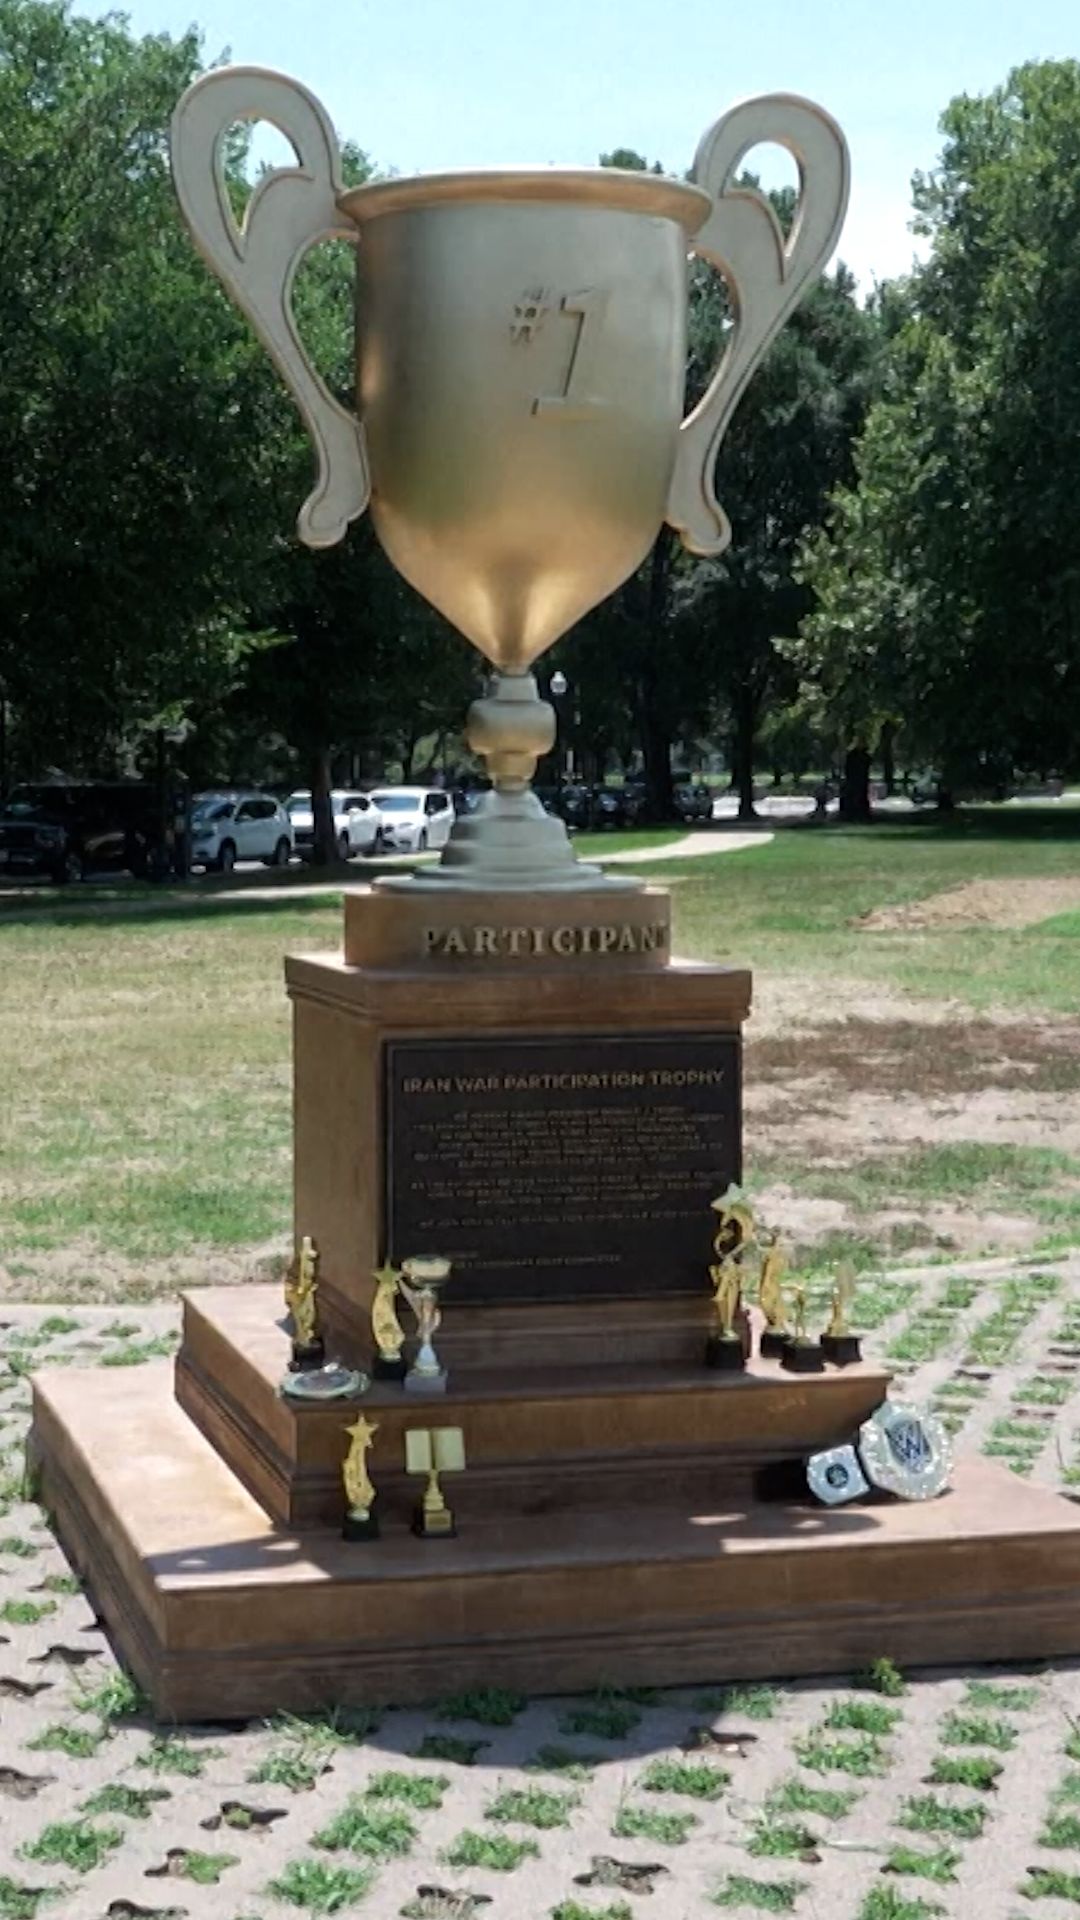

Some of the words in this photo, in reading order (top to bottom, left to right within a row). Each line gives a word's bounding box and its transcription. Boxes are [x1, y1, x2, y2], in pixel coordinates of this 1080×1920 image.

[507, 284, 614, 418] #1
[403, 1077, 450, 1093] IRAN
[454, 1075, 499, 1092] WAR
[503, 1072, 645, 1090] PARTICIPATION
[650, 1069, 725, 1087] TROPHY
